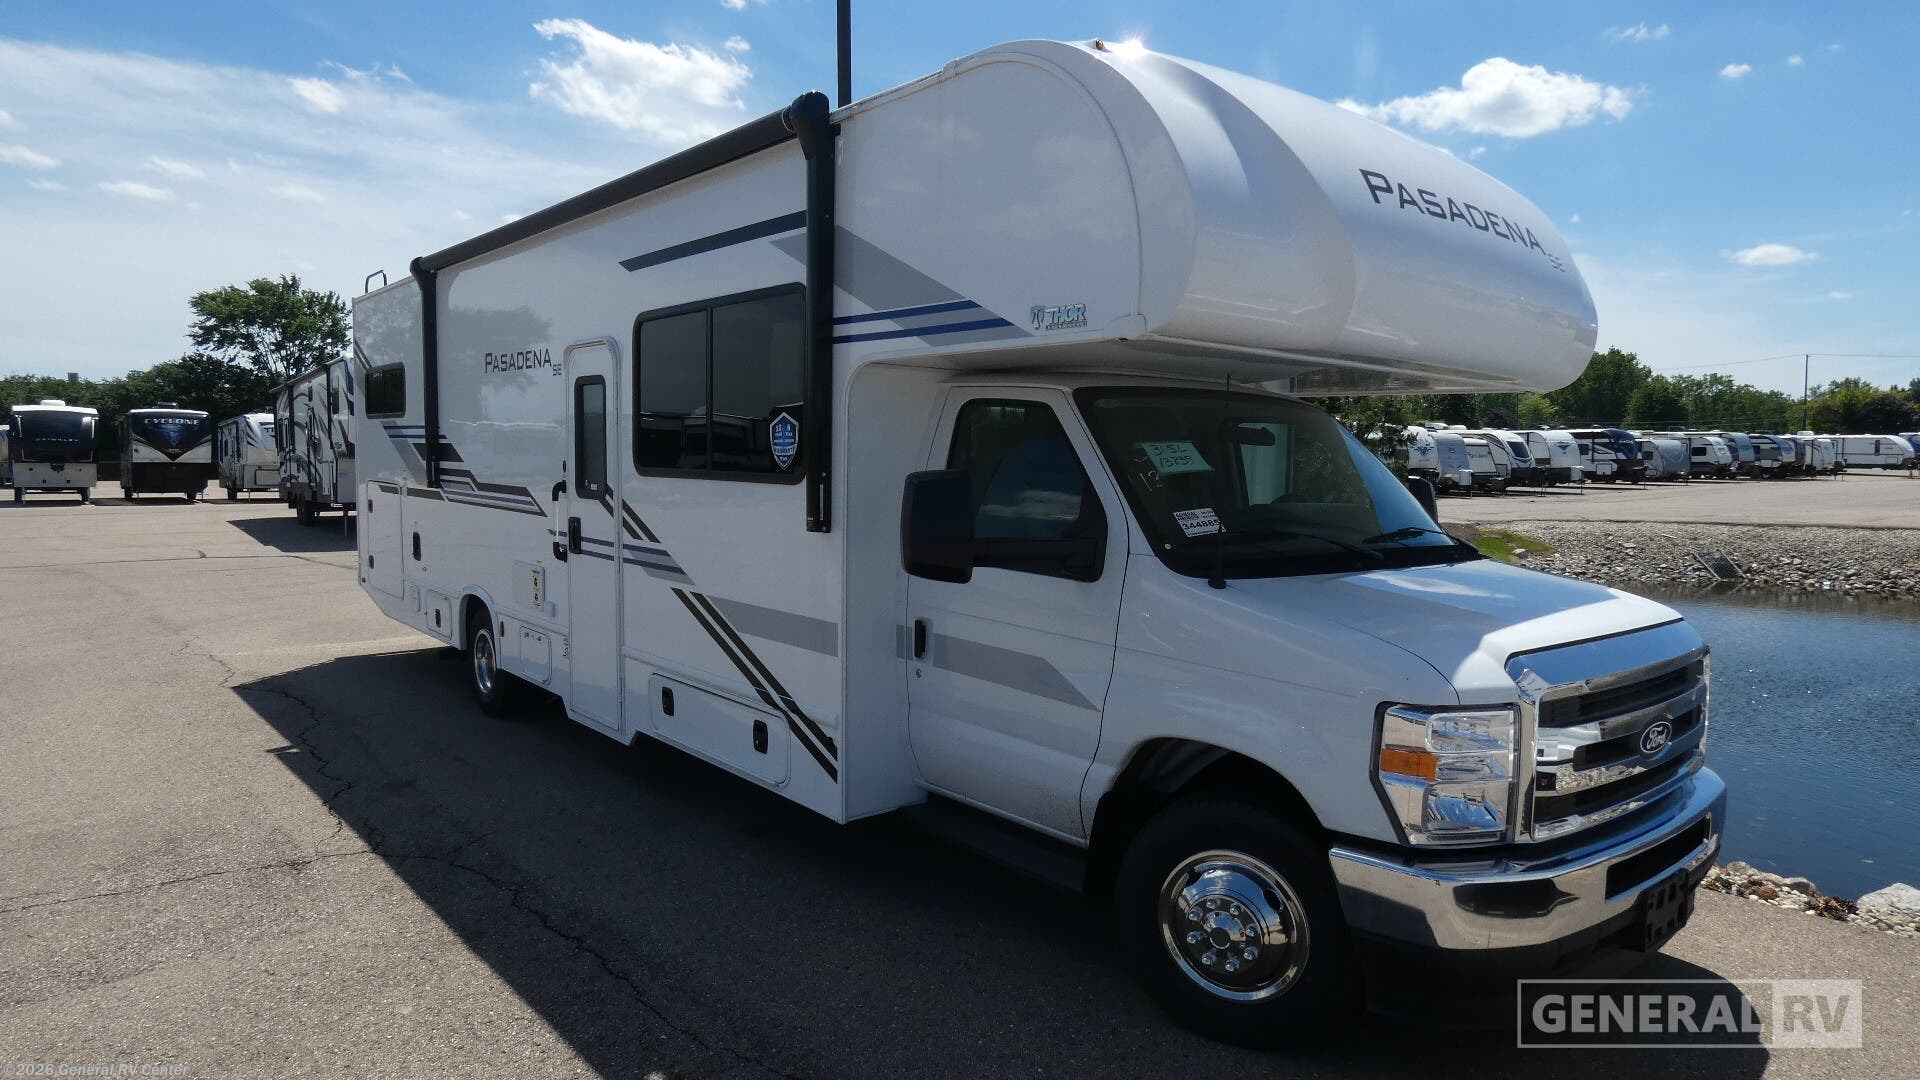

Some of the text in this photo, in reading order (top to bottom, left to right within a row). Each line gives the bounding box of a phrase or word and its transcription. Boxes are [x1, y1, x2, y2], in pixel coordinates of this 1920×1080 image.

[1359, 168, 1546, 256] PASADENA
[1045, 303, 1087, 324] THOR
[485, 348, 552, 374] PASADENA
[144, 418, 201, 426] CYCLONE
[1646, 726, 1667, 749] Ford
